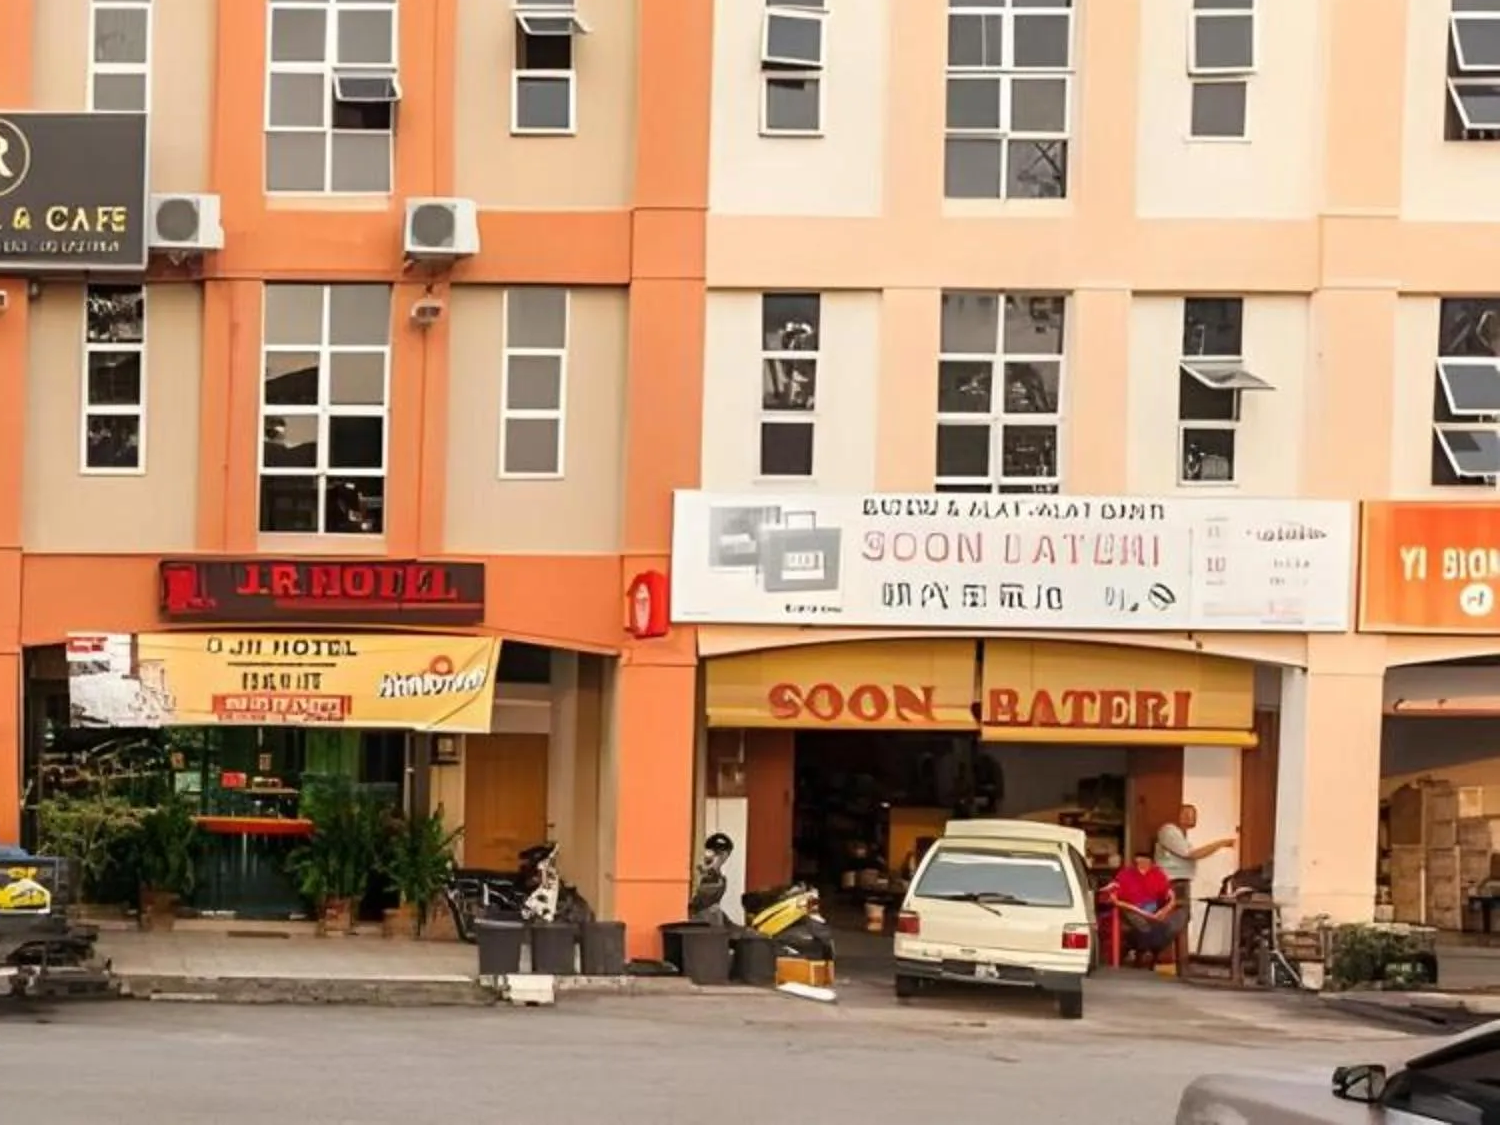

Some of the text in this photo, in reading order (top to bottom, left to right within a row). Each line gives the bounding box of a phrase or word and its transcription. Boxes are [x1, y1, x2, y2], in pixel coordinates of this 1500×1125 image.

[12, 207, 32, 230] &
[46, 206, 128, 232] CAFE
[862, 530, 984, 564] SOON
[767, 682, 1193, 728] SOON BATERI
